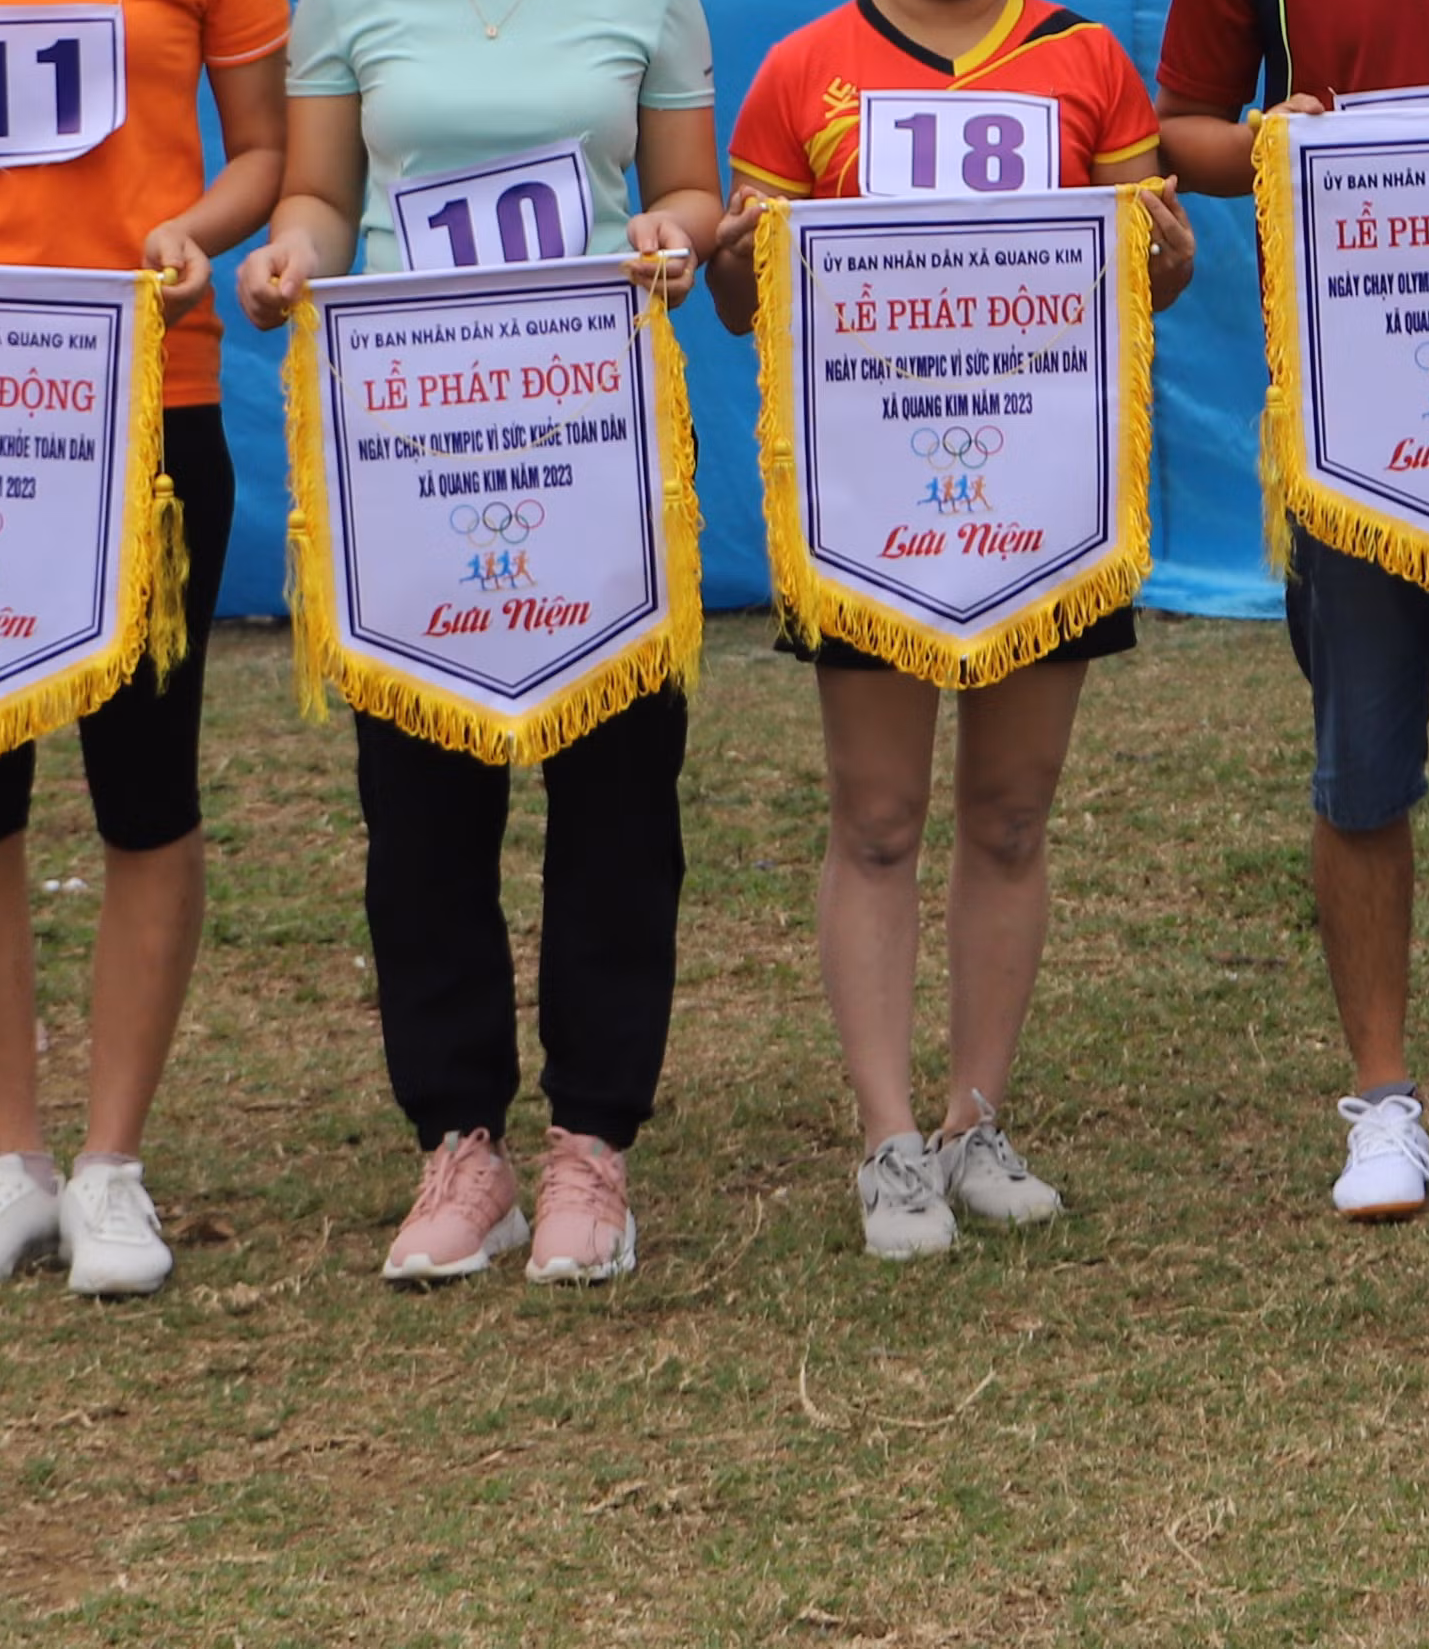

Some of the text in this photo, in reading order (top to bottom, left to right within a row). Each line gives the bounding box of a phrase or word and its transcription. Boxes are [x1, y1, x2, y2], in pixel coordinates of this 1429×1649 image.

[894, 113, 1025, 192] 18
[427, 181, 564, 267] 10
[1336, 200, 1379, 252] LỄ
[835, 282, 1085, 335] LỄ PHÁT ĐỘNG
[364, 354, 621, 412] LỄ PHÁT ĐỘNG
